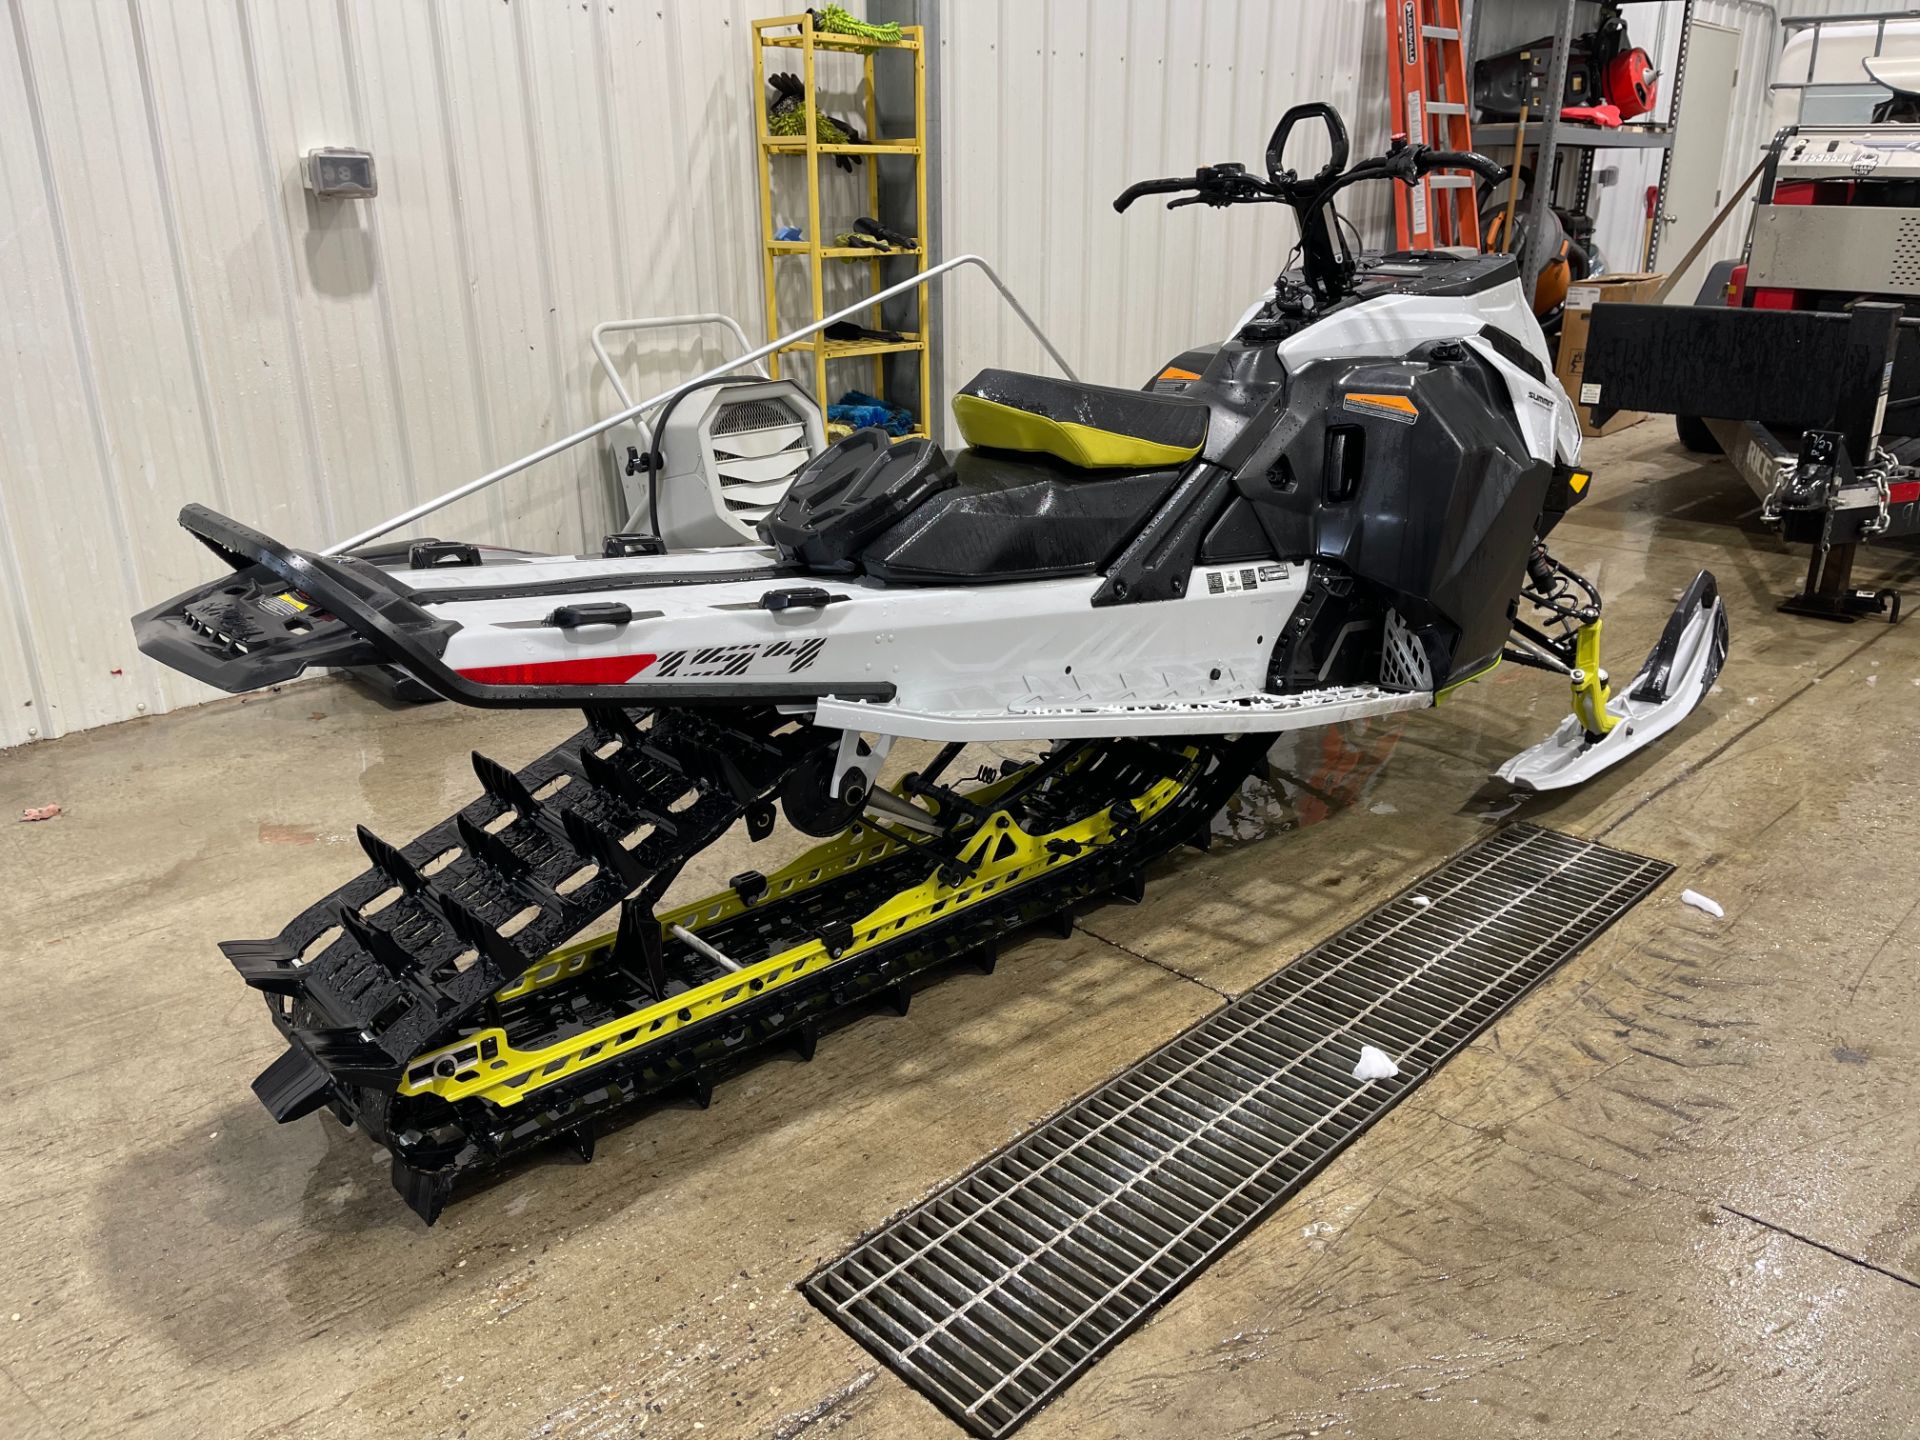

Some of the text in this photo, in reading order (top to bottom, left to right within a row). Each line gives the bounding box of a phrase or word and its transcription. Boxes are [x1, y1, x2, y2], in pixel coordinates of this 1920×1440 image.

[1528, 391, 1554, 408] SUMMIT
[1746, 440, 1772, 487] RICE
[656, 637, 828, 677] 154
